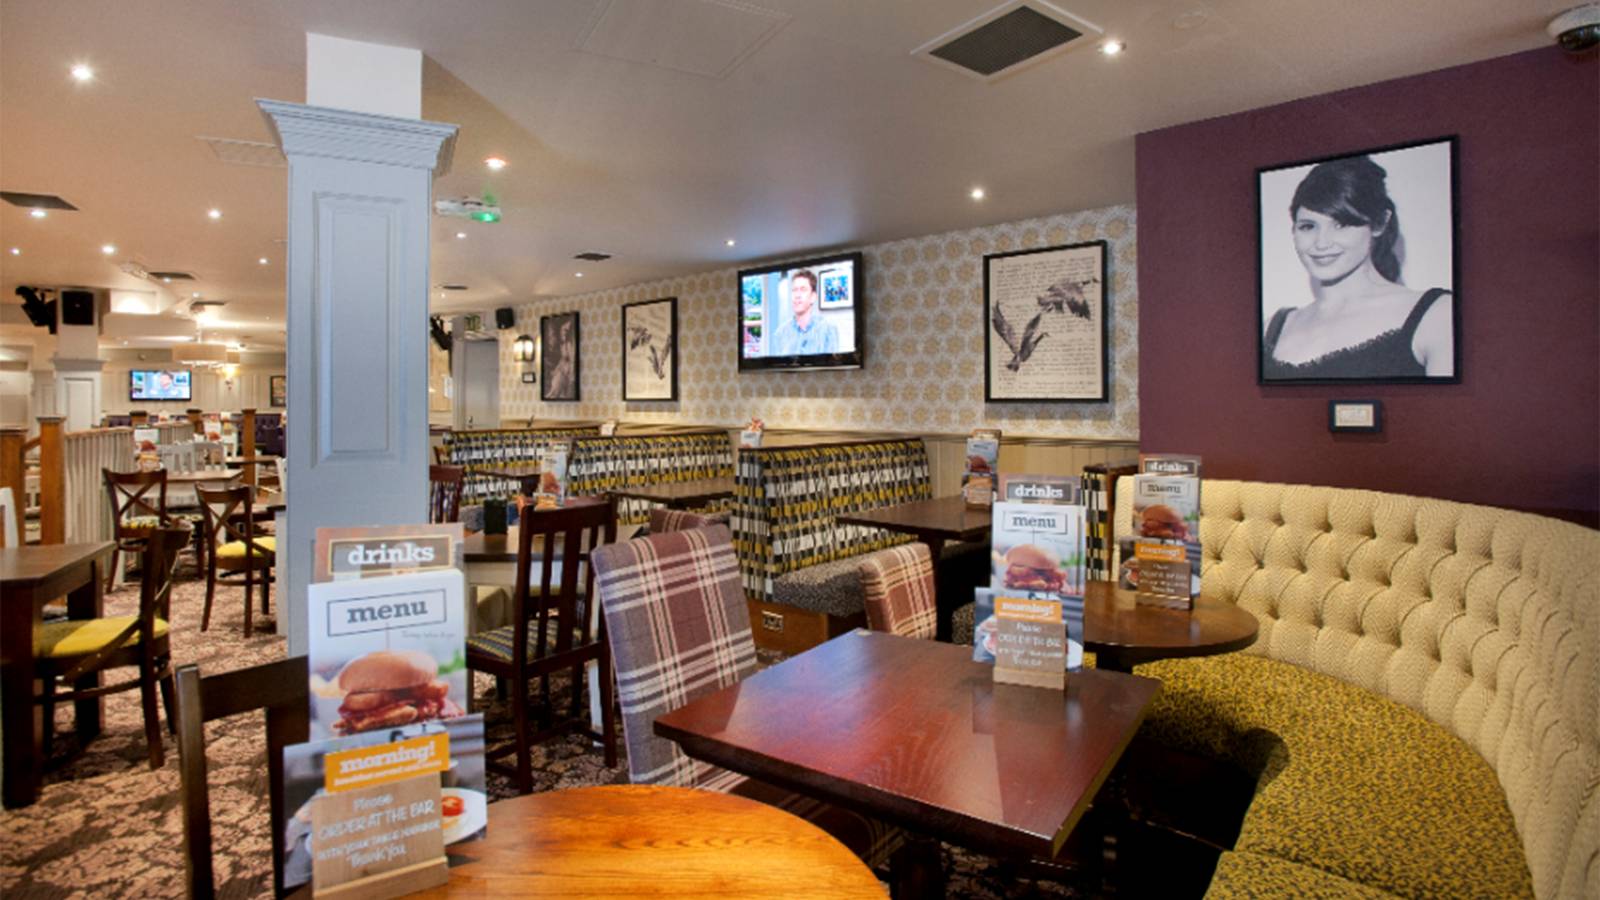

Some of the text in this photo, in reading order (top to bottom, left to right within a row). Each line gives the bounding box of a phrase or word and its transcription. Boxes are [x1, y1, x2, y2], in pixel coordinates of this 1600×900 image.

[1150, 461, 1188, 472] drinks
[1015, 484, 1064, 498] drinks
[1012, 516, 1056, 528] menu
[348, 542, 435, 565] drinks
[347, 600, 428, 624] menu
[340, 741, 436, 773] morning!
[320, 799, 435, 840] ORDER AT THE BAR
